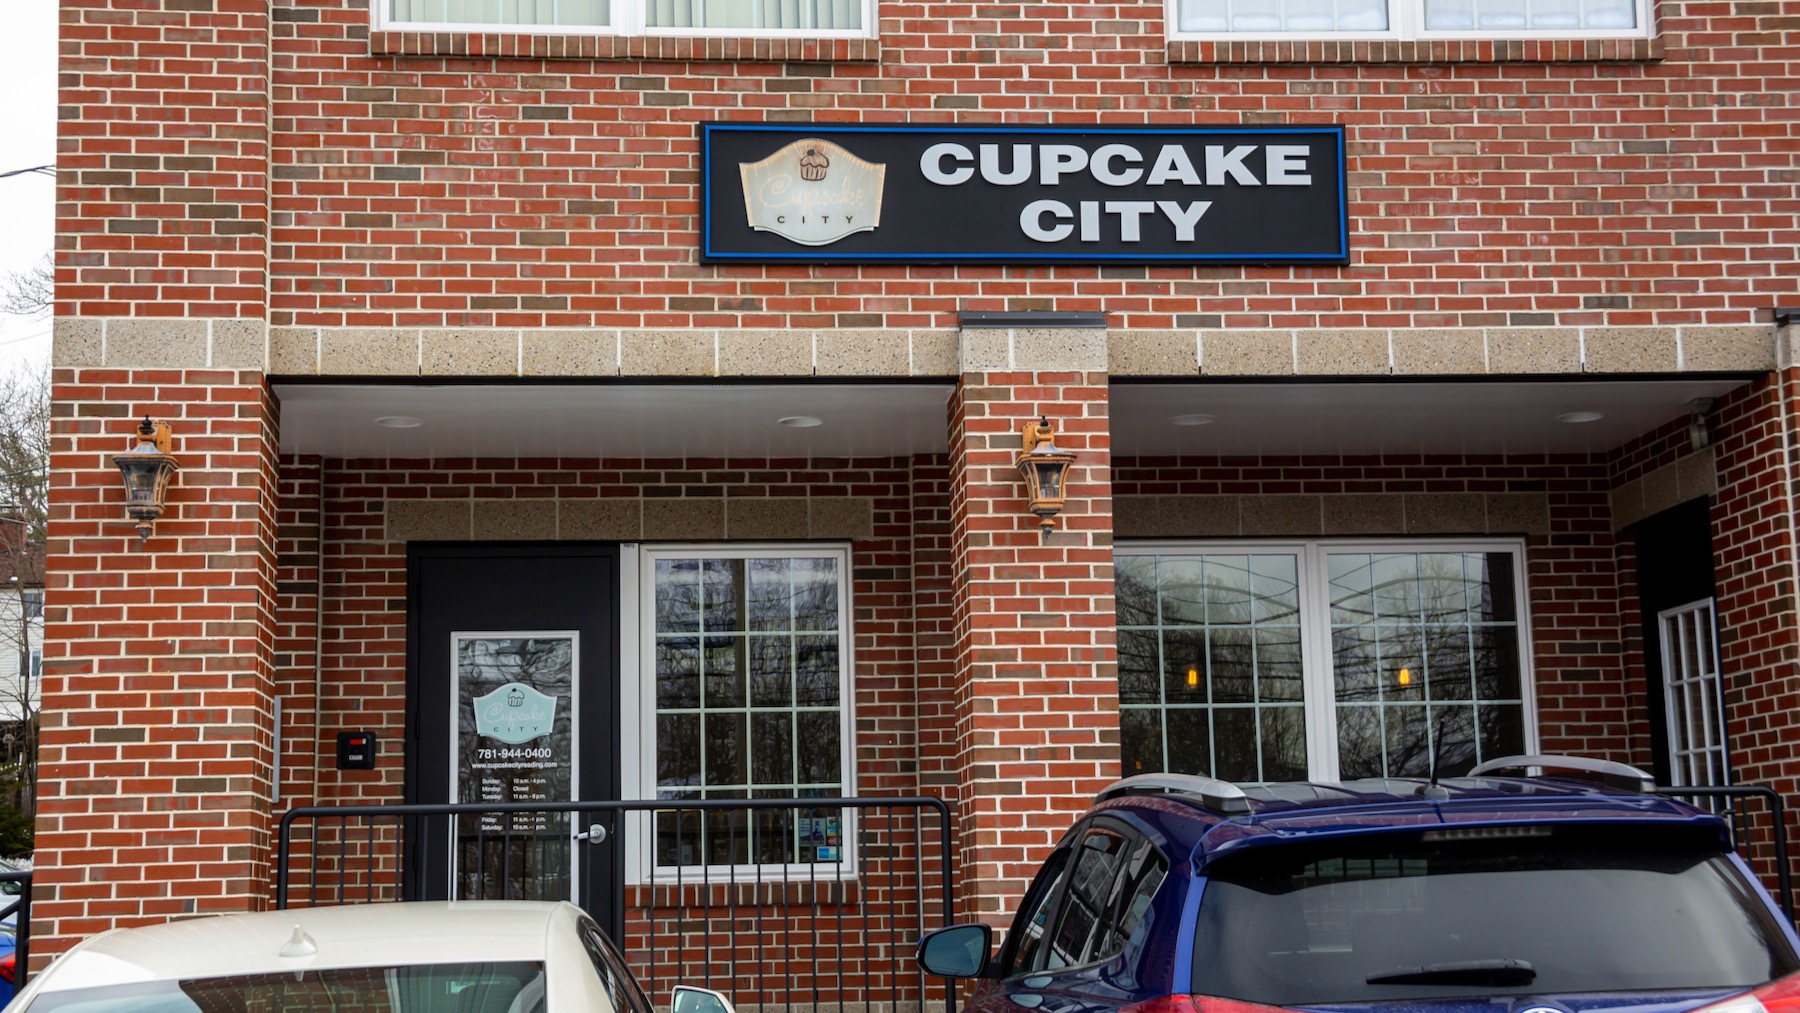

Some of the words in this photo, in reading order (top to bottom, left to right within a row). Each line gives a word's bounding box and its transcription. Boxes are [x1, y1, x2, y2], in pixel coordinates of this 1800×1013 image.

[920, 142, 1312, 187] CUPCAKE
[759, 173, 865, 221] Cupcake
[777, 215, 853, 224] CITY
[1019, 199, 1213, 243] CITY
[483, 702, 546, 731] Cupcake
[472, 761, 558, 769] www.cupcakecityreading.com
[478, 748, 552, 759] 781-944-0400
